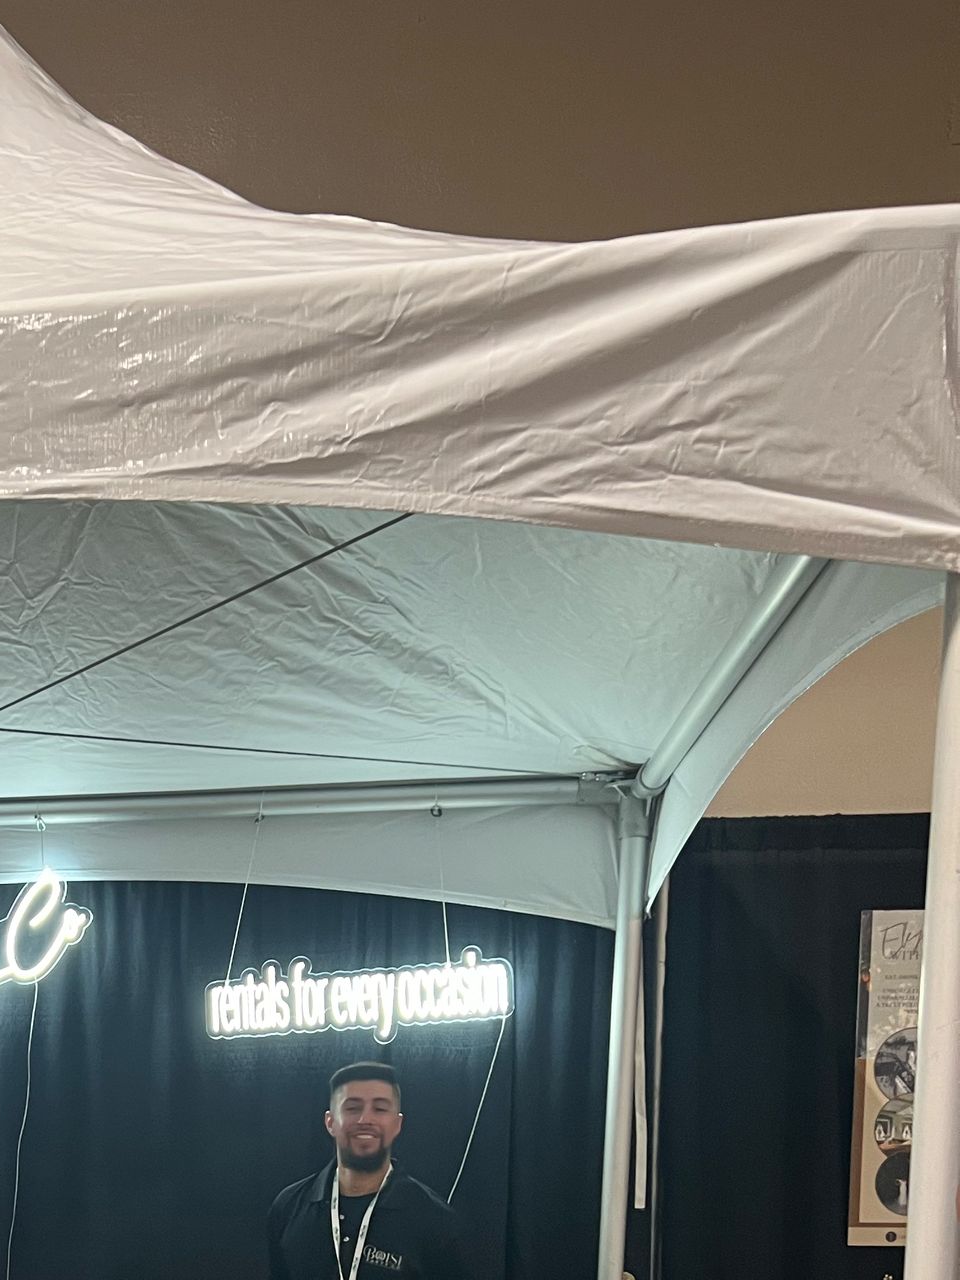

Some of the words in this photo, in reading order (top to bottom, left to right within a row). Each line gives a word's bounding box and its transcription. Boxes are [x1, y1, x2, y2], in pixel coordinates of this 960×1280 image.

[210, 965, 290, 1033] rentals
[291, 961, 329, 1027] for
[329, 973, 396, 1039] every
[396, 951, 509, 1020] occasion
